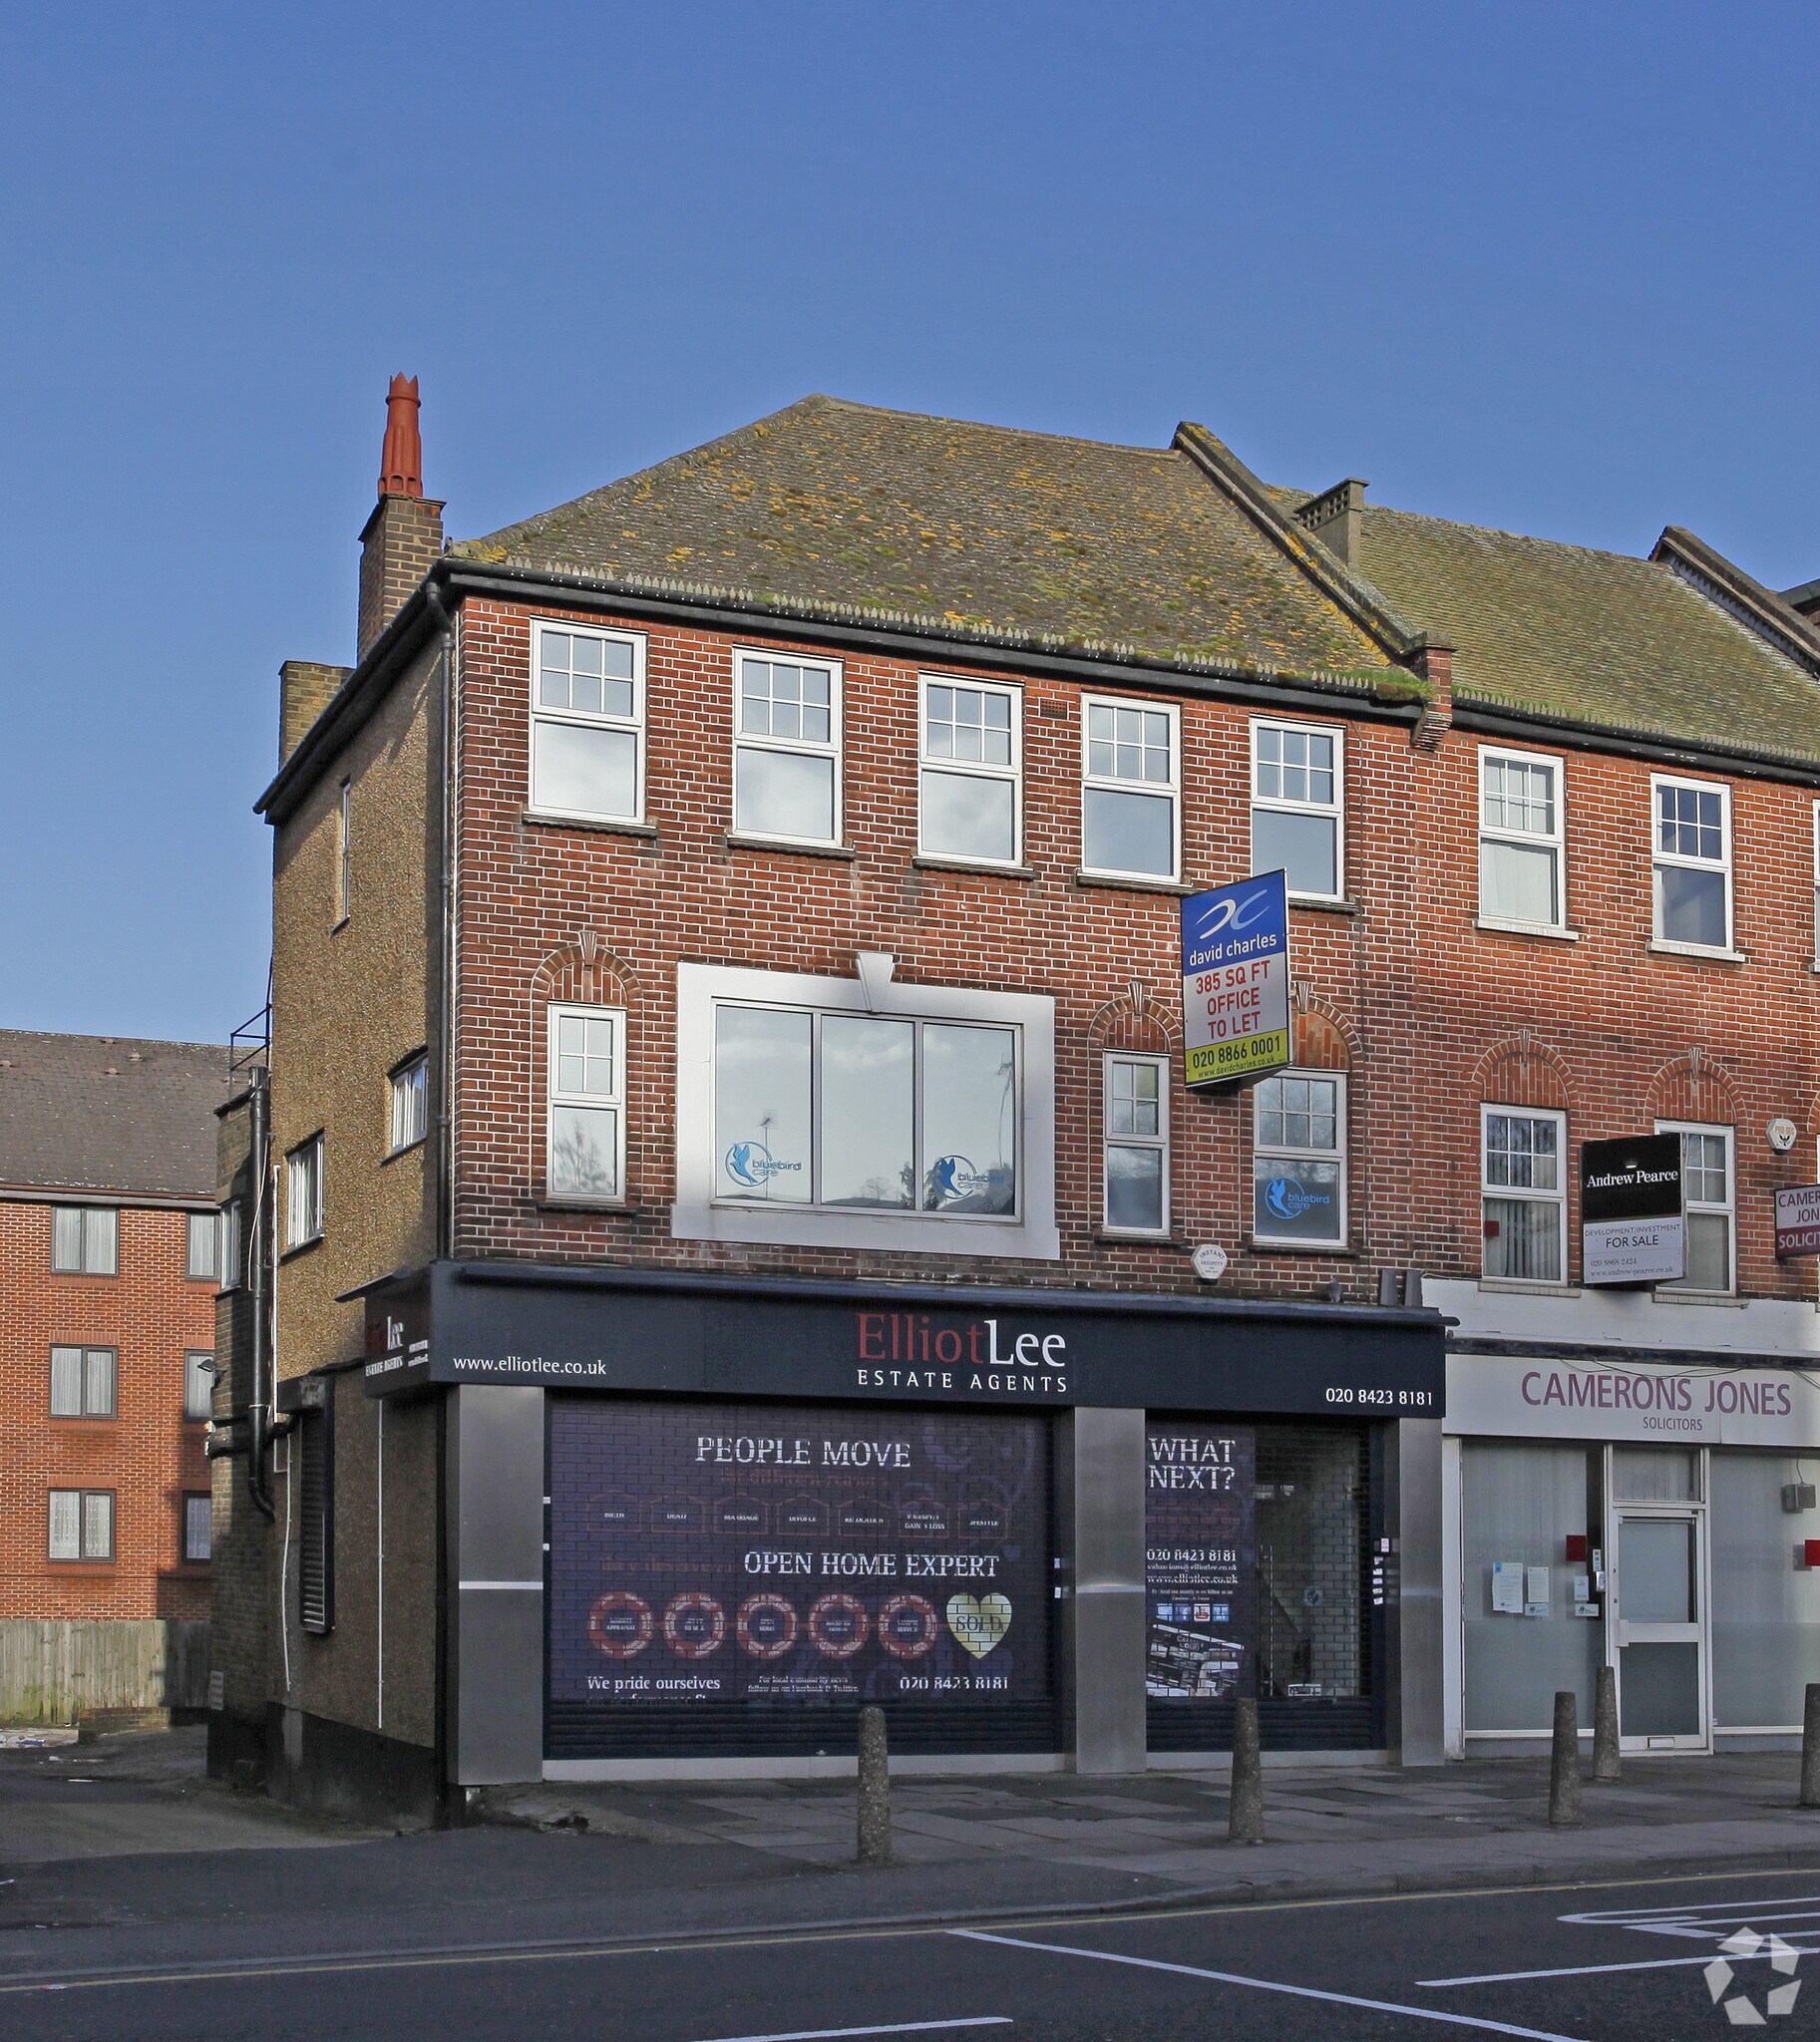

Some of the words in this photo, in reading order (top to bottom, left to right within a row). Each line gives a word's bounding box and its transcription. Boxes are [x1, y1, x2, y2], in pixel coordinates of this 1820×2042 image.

[1189, 943, 1223, 966] david
[1226, 933, 1277, 958] charles
[1196, 972, 1221, 995] 385
[1226, 966, 1247, 988] SQ
[1252, 960, 1271, 982] FT
[1207, 987, 1261, 1016] OFFICE
[1208, 1020, 1227, 1040] TO
[1232, 1011, 1261, 1035] LET
[1192, 1050, 1215, 1069] 020
[1219, 1042, 1248, 1065] 8866
[1252, 1035, 1280, 1057] 0001
[1198, 1055, 1275, 1079] www.davidcharles.co.uk
[751, 1159, 802, 1171] bluebird
[1586, 1173, 1635, 1189] Andrew
[1636, 1170, 1678, 1185] Pearce
[1287, 1192, 1330, 1203] bluebird
[1585, 1223, 1681, 1237] DEVELOPMENT/INVESTMENT
[1606, 1236, 1629, 1248] FOR
[1632, 1235, 1659, 1247] SALE
[1199, 1249, 1225, 1259] INSTANT
[856, 1313, 1066, 1367] ElliotLee
[453, 1356, 606, 1375] www.elliotlee.co.uk
[858, 1369, 952, 1388] ESTATE
[970, 1374, 1067, 1393] AGENTS
[1325, 1388, 1353, 1403] 020
[1358, 1389, 1393, 1404] 8423
[1398, 1391, 1432, 1405] 8181
[1521, 1371, 1692, 1411] CAMERONS
[1704, 1380, 1791, 1416] JONES
[1642, 1417, 1702, 1431] SOLICITORS
[695, 1436, 811, 1464] PEOPLE
[821, 1440, 911, 1468] MOVE
[1148, 1437, 1236, 1463] WHAT
[1148, 1465, 1236, 1490] NEXT?
[744, 1551, 813, 1574] OPEN
[821, 1552, 897, 1575] HOME
[906, 1554, 999, 1576] EXPERT
[1147, 1548, 1171, 1560] 020
[1174, 1548, 1205, 1561] 8423
[1209, 1549, 1236, 1561] 8181
[1147, 1573, 1238, 1583] www.elliotlee.co.uk
[956, 1615, 1002, 1632] SOLD
[586, 1676, 609, 1689] We
[614, 1675, 650, 1693] pride
[655, 1675, 721, 1690] ourselves
[900, 1677, 928, 1690] 020
[933, 1677, 970, 1690] 8423
[975, 1677, 1008, 1690] 8181
